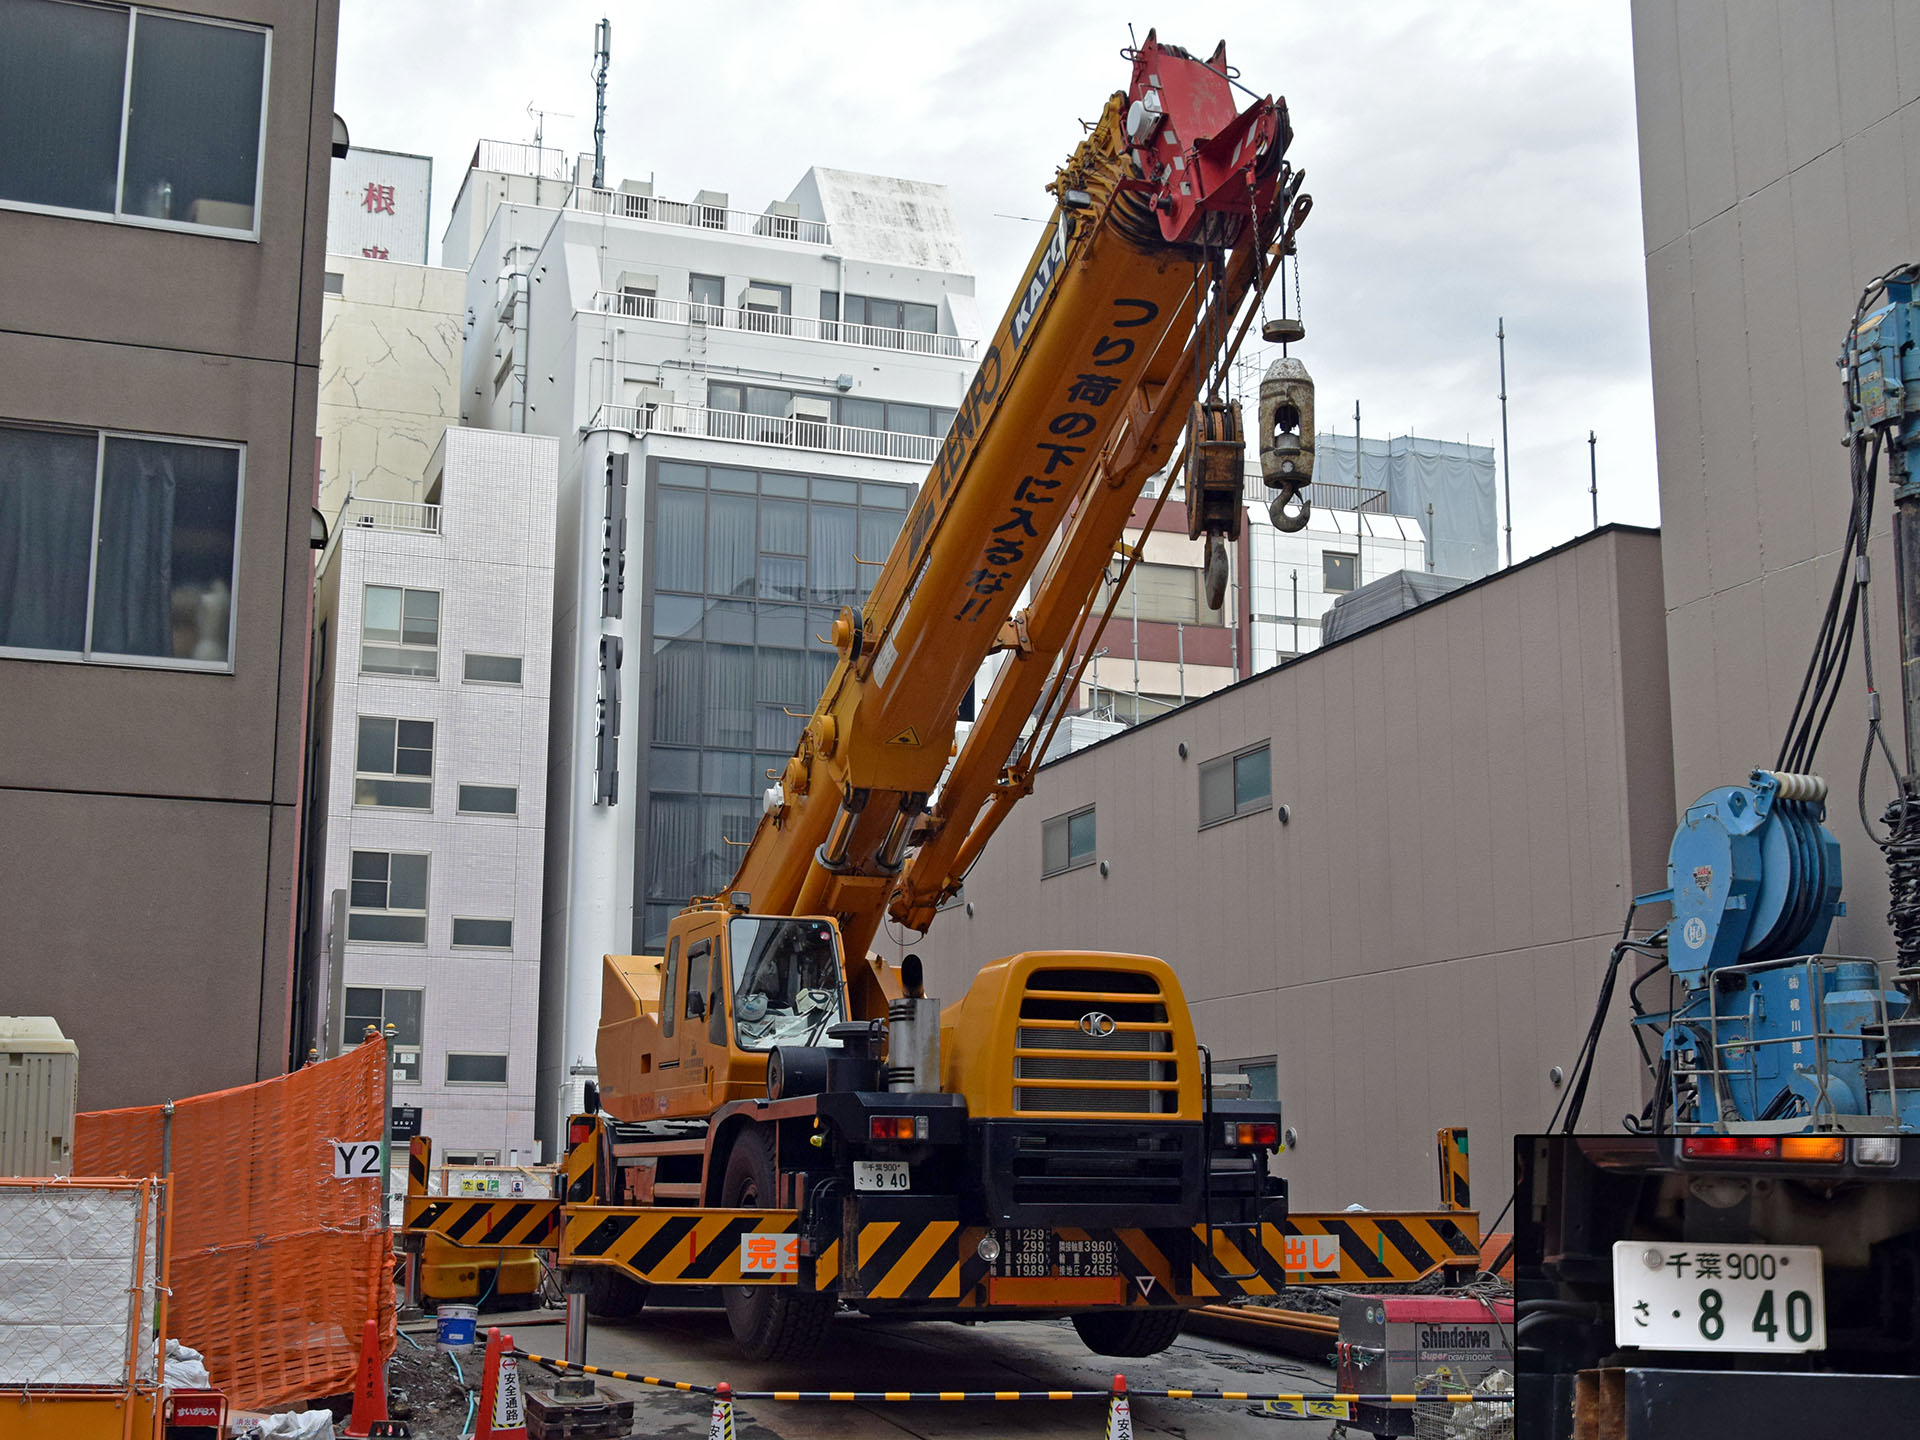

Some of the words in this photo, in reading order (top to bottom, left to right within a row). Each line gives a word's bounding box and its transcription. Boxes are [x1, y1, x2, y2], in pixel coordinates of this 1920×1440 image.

[338, 1145, 381, 1175] Y2
[1665, 1252, 1776, 1280] 千葉900
[1421, 1326, 1490, 1349] shindaiwa
[1421, 1351, 1447, 1362] Super
[504, 1372, 519, 1422] 安全通路
